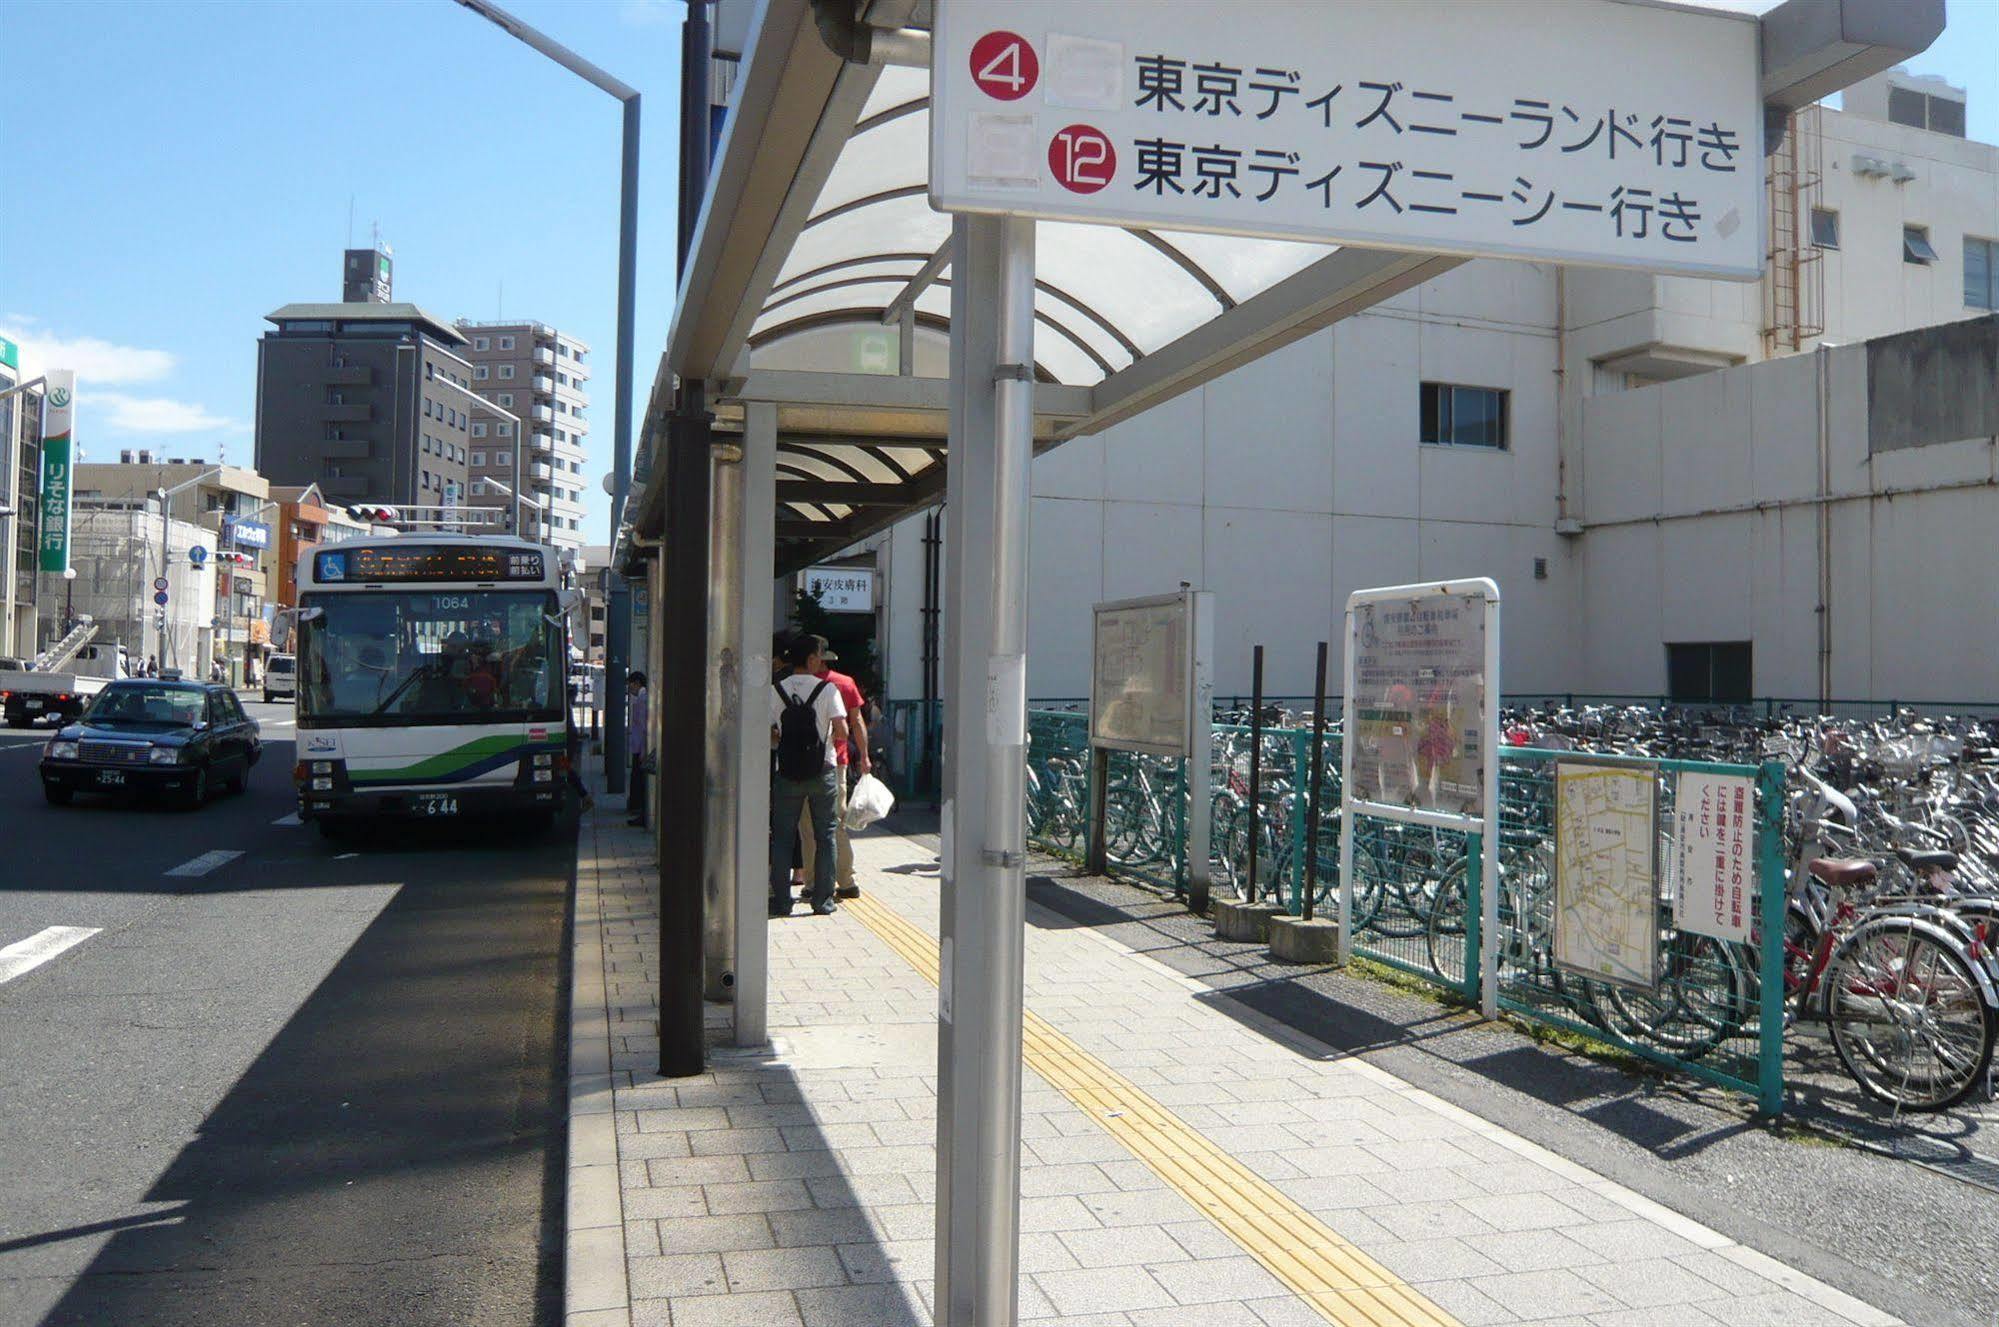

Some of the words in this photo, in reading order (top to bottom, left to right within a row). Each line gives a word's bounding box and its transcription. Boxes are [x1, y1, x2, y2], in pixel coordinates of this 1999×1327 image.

[978, 42, 1026, 91] 4
[1134, 54, 1741, 173] 東京ディズニーランド行き
[1058, 133, 1107, 185] 12
[1133, 137, 1702, 242] 東京ディズニーシー行き
[45, 463, 66, 551] りそな銀行
[435, 598, 469, 609] 1064
[1700, 783, 1711, 839] ください
[1714, 784, 1727, 926] には鍵を二重に掛けて
[1731, 785, 1745, 929] 盗難防止のため自転車
